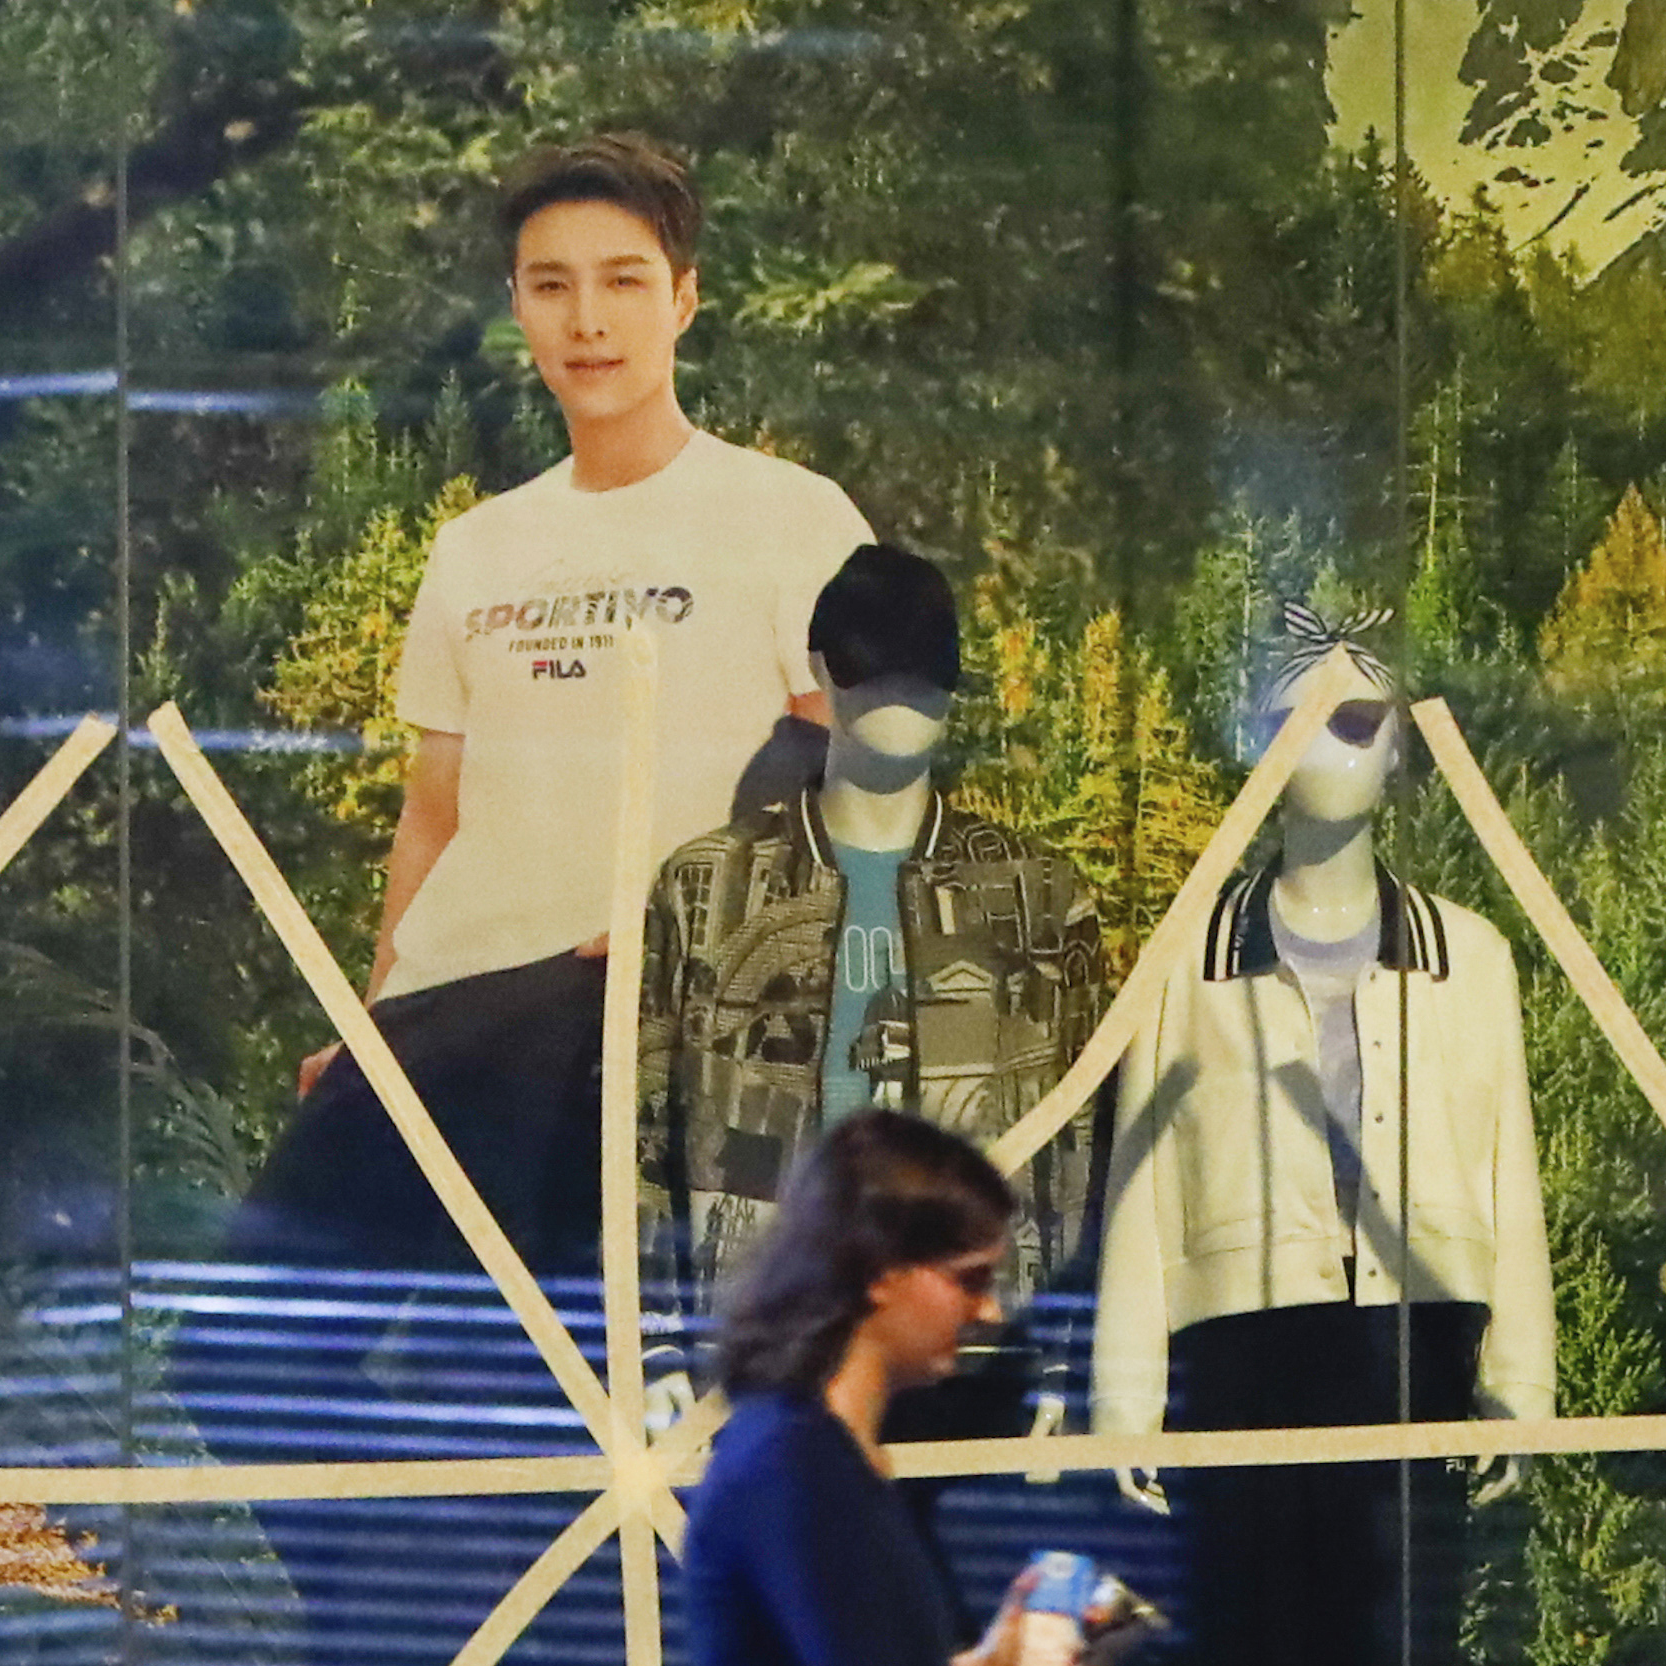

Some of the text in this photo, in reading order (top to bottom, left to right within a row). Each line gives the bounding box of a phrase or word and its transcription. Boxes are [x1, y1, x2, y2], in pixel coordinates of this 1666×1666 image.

[465, 587, 694, 642] SPORTIVO
[509, 635, 614, 652] FOUNDED IN 1911
[531, 660, 586, 679] FILA
